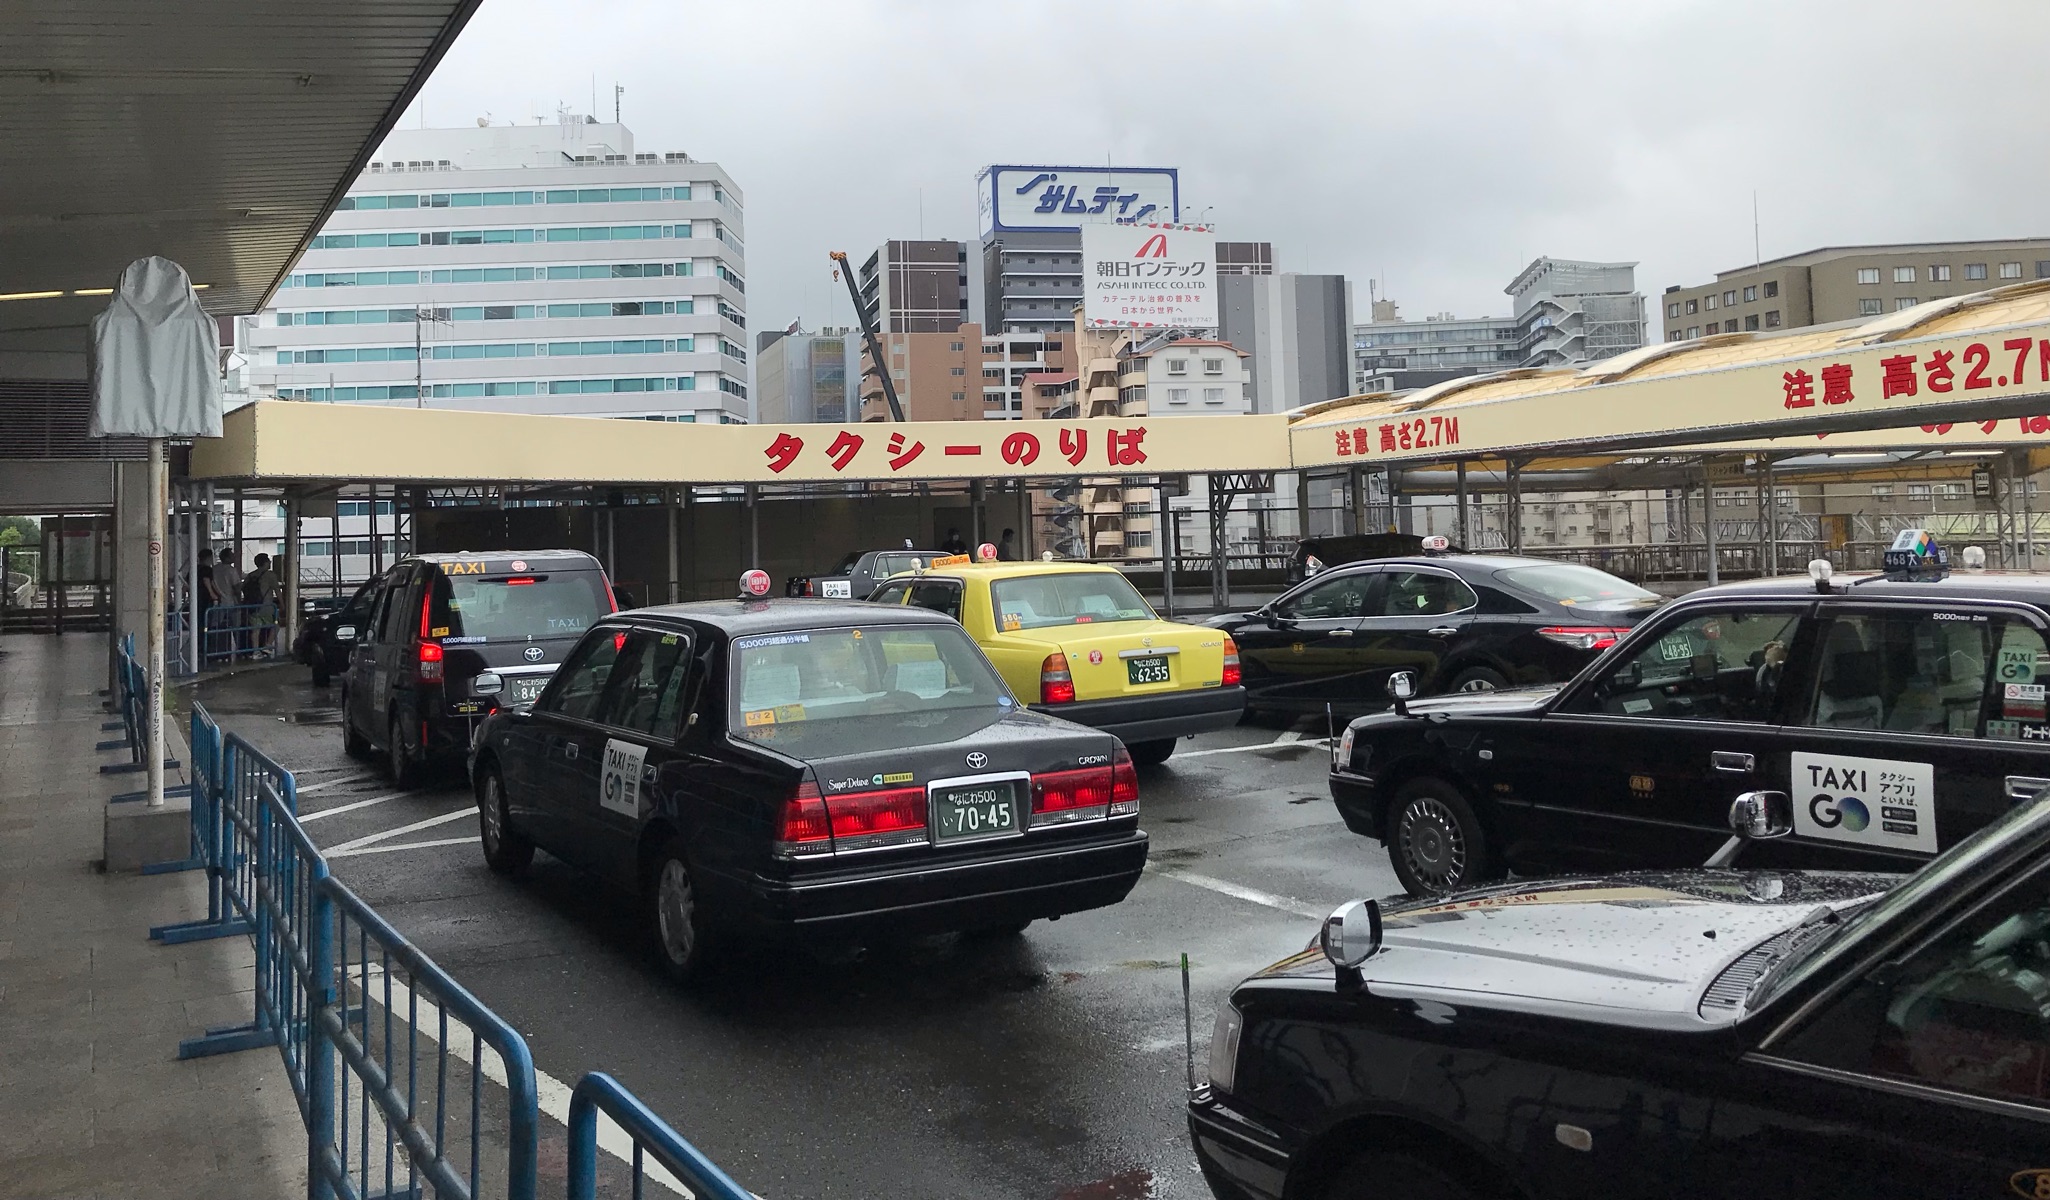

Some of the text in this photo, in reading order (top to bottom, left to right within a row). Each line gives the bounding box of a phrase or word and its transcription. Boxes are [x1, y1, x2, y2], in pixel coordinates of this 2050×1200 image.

[1034, 185, 1140, 214] サムティ
[1096, 260, 1206, 277] 朝日インテック
[1103, 295, 1201, 303] カテーテル治療の普及を
[1121, 306, 1183, 314] 日本から世界へ
[1782, 363, 1855, 410] 注意
[1335, 416, 1460, 457] 注意 高さ2.7M
[764, 426, 1148, 473] タクシーのりば
[1886, 553, 1906, 565] 468
[1907, 551, 1918, 566] 大
[441, 562, 486, 575] TAXI
[548, 618, 580, 628] TAXI
[852, 629, 863, 639] 2
[1668, 643, 1690, 658] 48-95
[2003, 652, 2031, 662] TAXI
[1137, 658, 1161, 667] なにわ500
[1138, 666, 1169, 682] 62-55
[2001, 664, 2031, 679] GO
[2023, 724, 2050, 739] カード
[608, 748, 627, 770] TAXI
[1078, 754, 1108, 764] CROWN
[828, 777, 870, 791] Super Deluxe
[1807, 765, 1867, 792] TAXI
[1880, 771, 1915, 782] タクシー
[605, 771, 623, 803] GO
[1880, 783, 1915, 797] アプリ
[954, 789, 997, 806] なにわ500
[1881, 795, 1918, 807] といえば、
[942, 802, 1011, 832] い 70-45
[1809, 793, 1871, 832] GO
